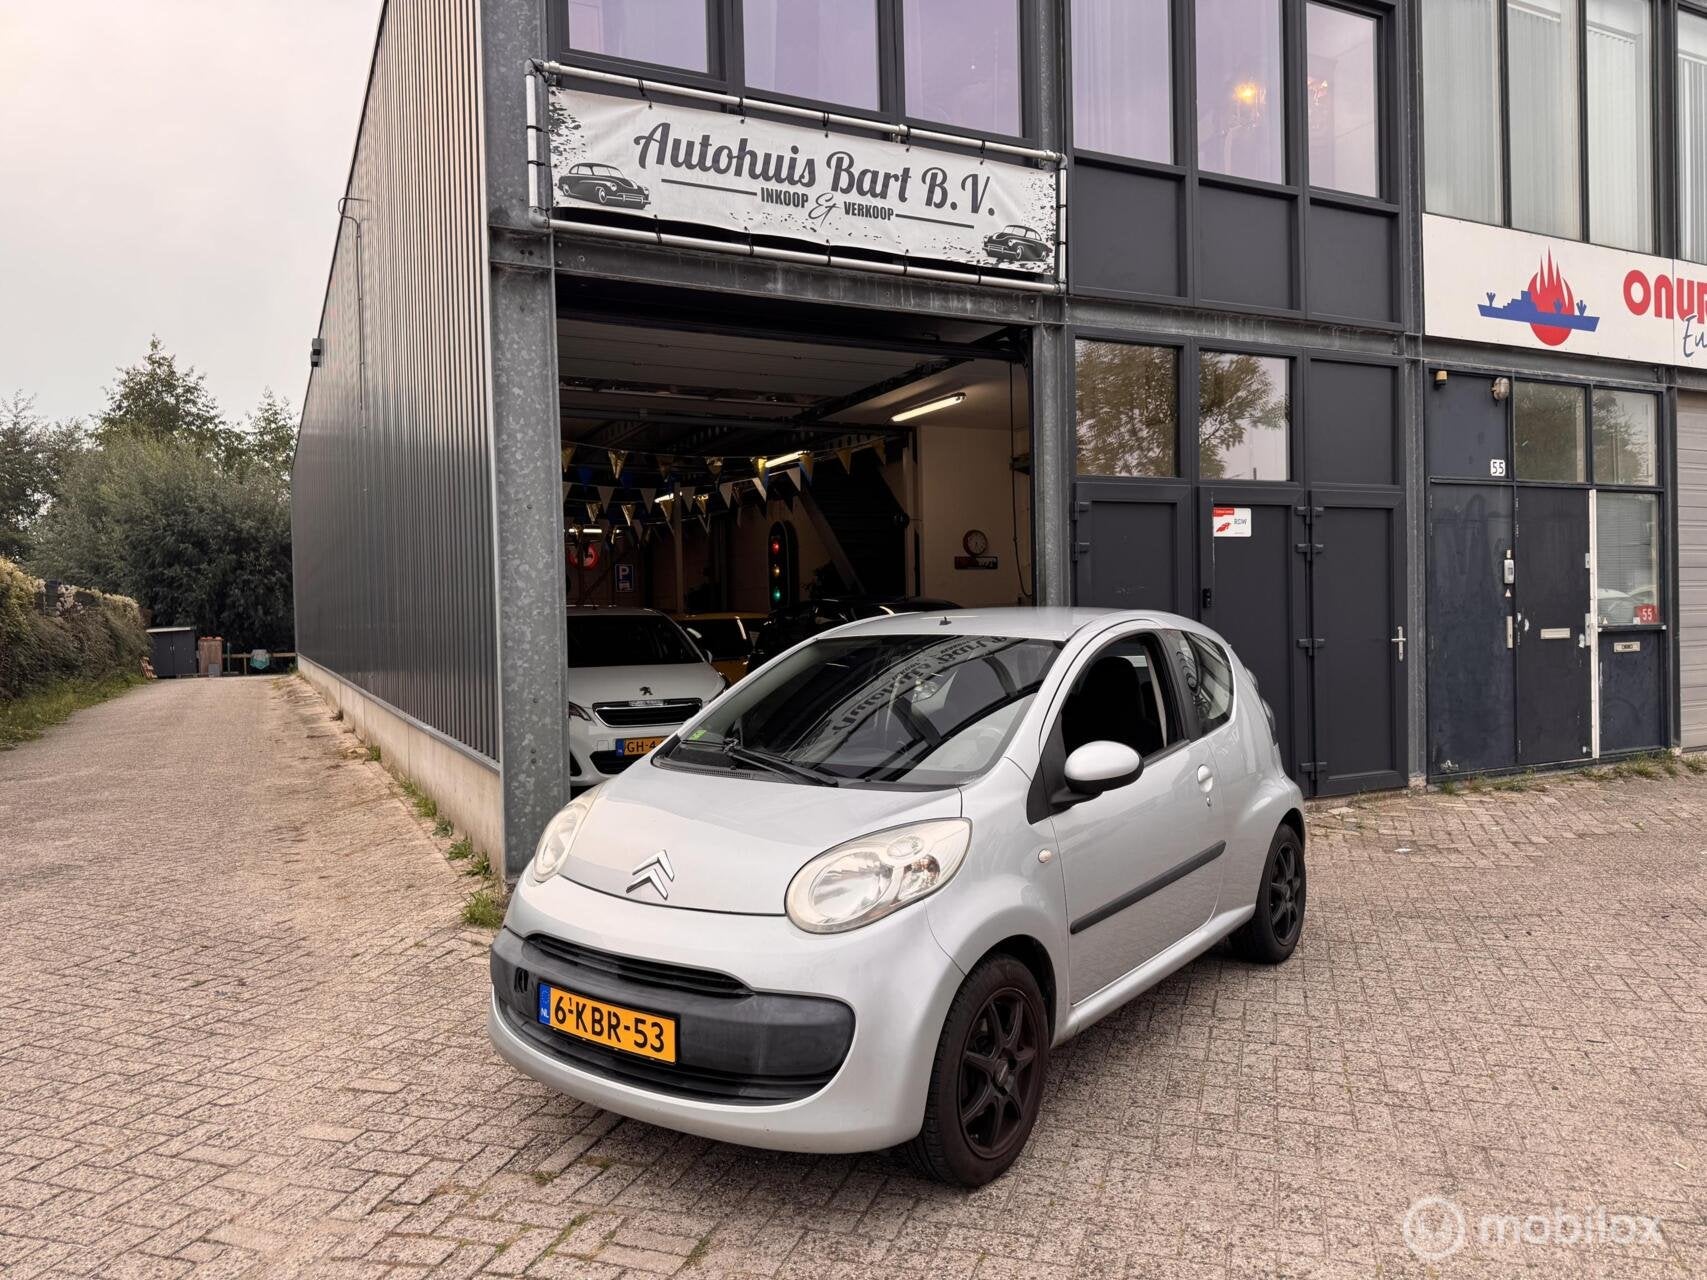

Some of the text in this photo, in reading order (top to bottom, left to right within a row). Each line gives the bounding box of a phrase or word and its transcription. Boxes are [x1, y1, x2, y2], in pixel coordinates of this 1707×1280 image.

[633, 122, 996, 216] Autohuis Bart B.V.
[760, 186, 894, 227] INKOOP & VERKOOP
[1492, 461, 1505, 475] 55
[618, 565, 630, 580] P
[1641, 607, 1653, 621] 55
[627, 739, 664, 753] GH-4
[554, 994, 665, 1053] 6-KBR-53
